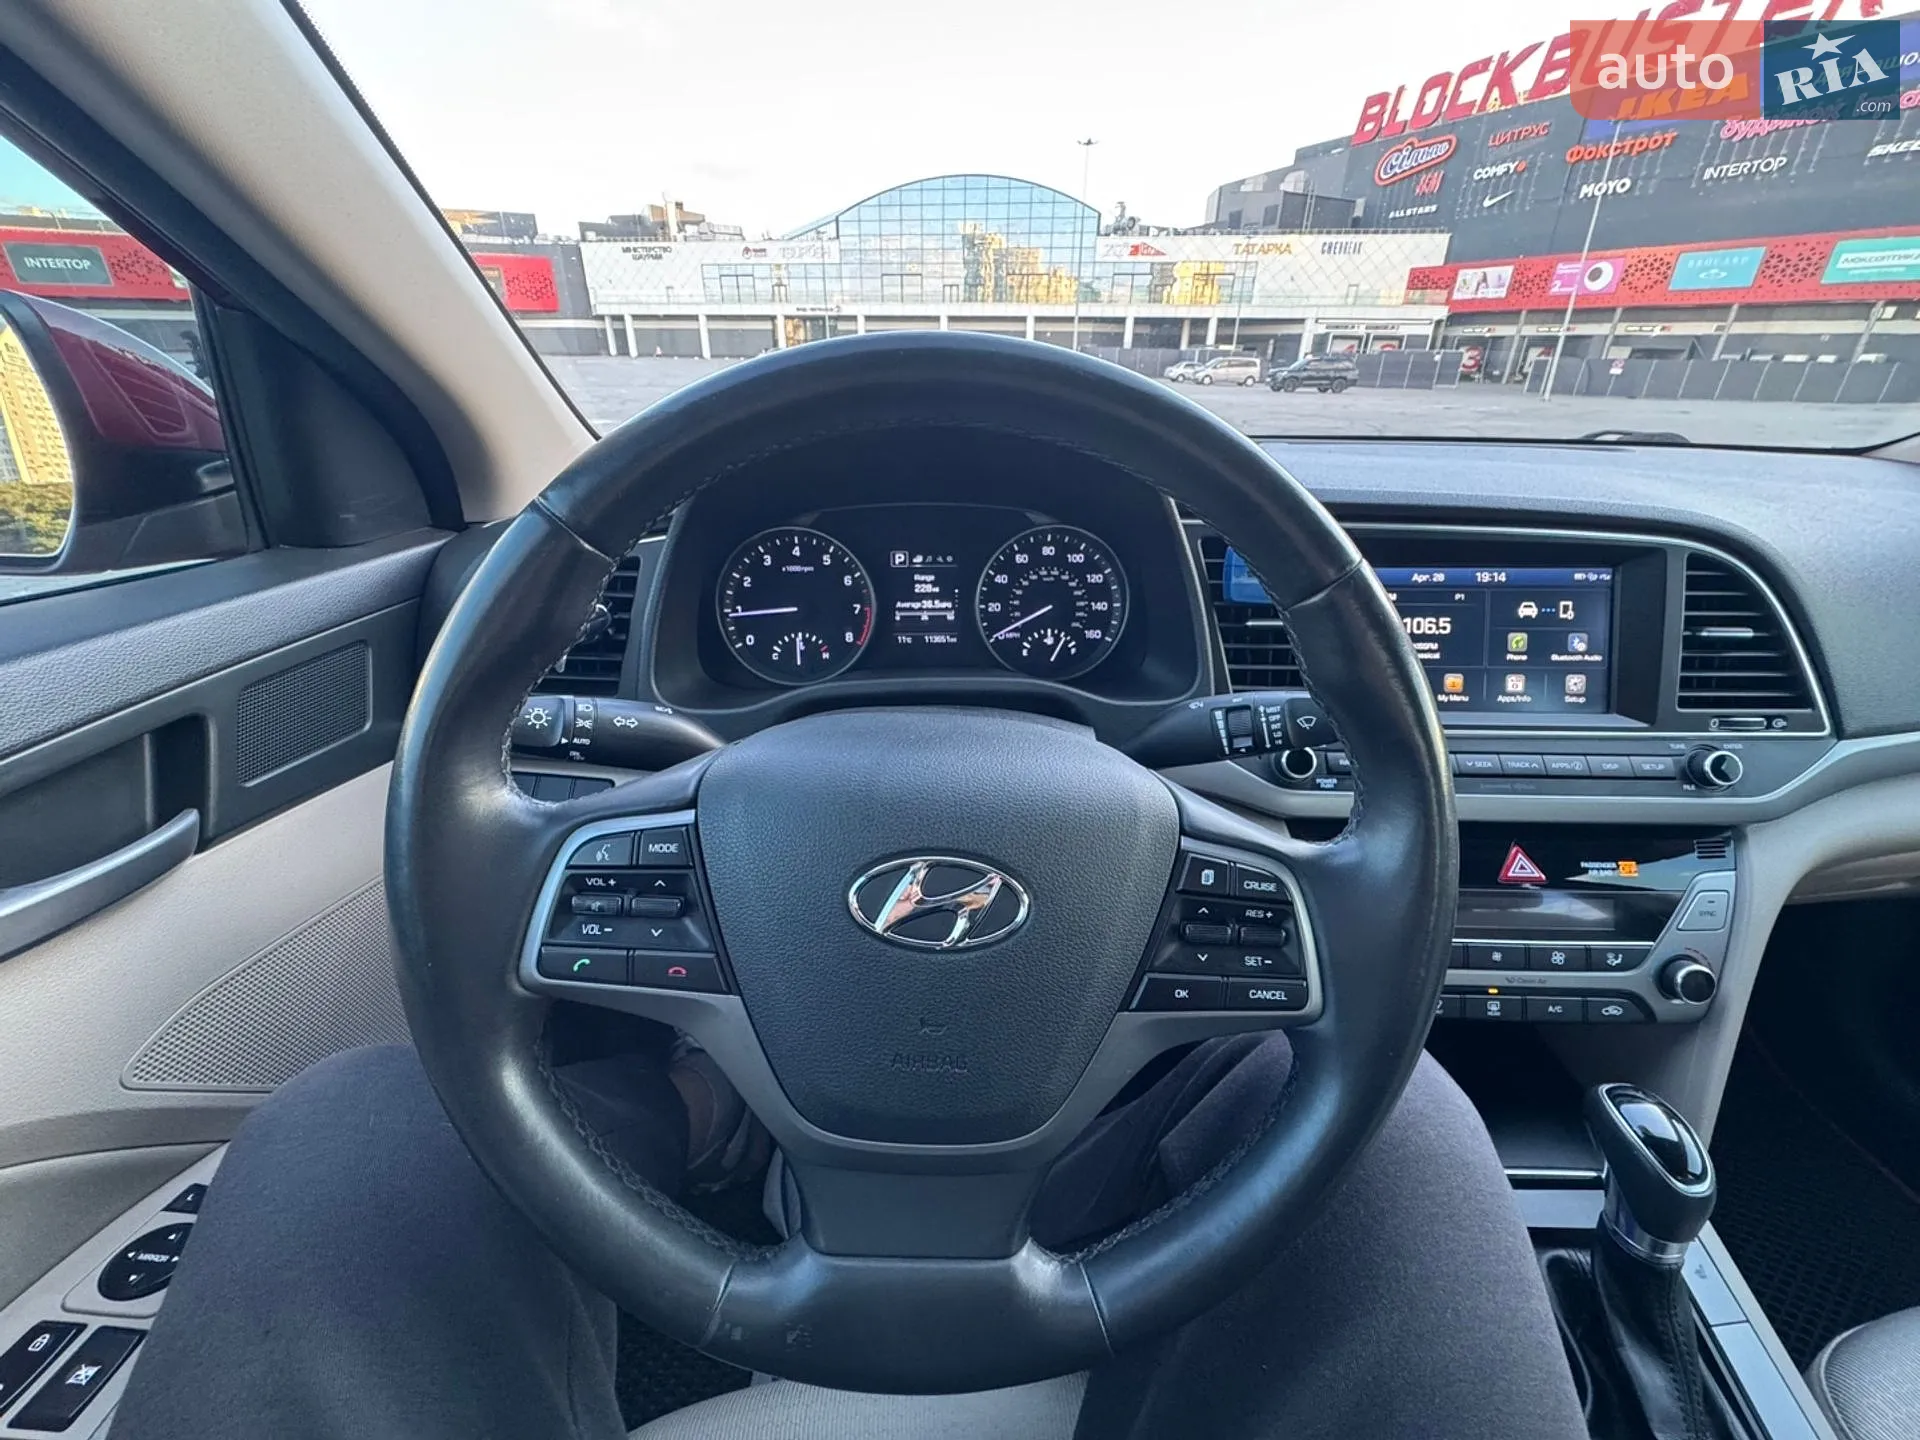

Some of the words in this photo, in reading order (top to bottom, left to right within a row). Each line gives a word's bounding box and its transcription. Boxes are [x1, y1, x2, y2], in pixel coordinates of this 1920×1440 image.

[1488, 121, 1551, 148] ЦИТРУС
[1473, 161, 1517, 180] COMFY
[1703, 156, 1788, 181] INTERTOP
[1578, 177, 1631, 199] MOYO
[24, 256, 91, 270] INTERTOP
[792, 546, 800, 557] 4
[1042, 546, 1055, 556] 80
[763, 555, 772, 566] 3
[823, 555, 831, 565] 5
[895, 553, 905, 565] P
[1015, 554, 1029, 564] 60
[1067, 554, 1084, 563] 100
[743, 576, 752, 587] 2
[844, 576, 852, 586] 6
[994, 574, 1008, 584] 40
[1086, 574, 1103, 583] 120
[1475, 572, 1506, 582] 19:14
[853, 604, 861, 614] 7
[988, 602, 1001, 612] 20
[1091, 602, 1108, 612] 140
[746, 635, 755, 645] 0
[845, 632, 853, 643] 8
[648, 843, 679, 853] MODE
[1243, 881, 1277, 892] CRUISE
[1174, 989, 1189, 999] OK
[1249, 989, 1288, 1001] CANCEL
[1548, 1005, 1563, 1013] A/C
